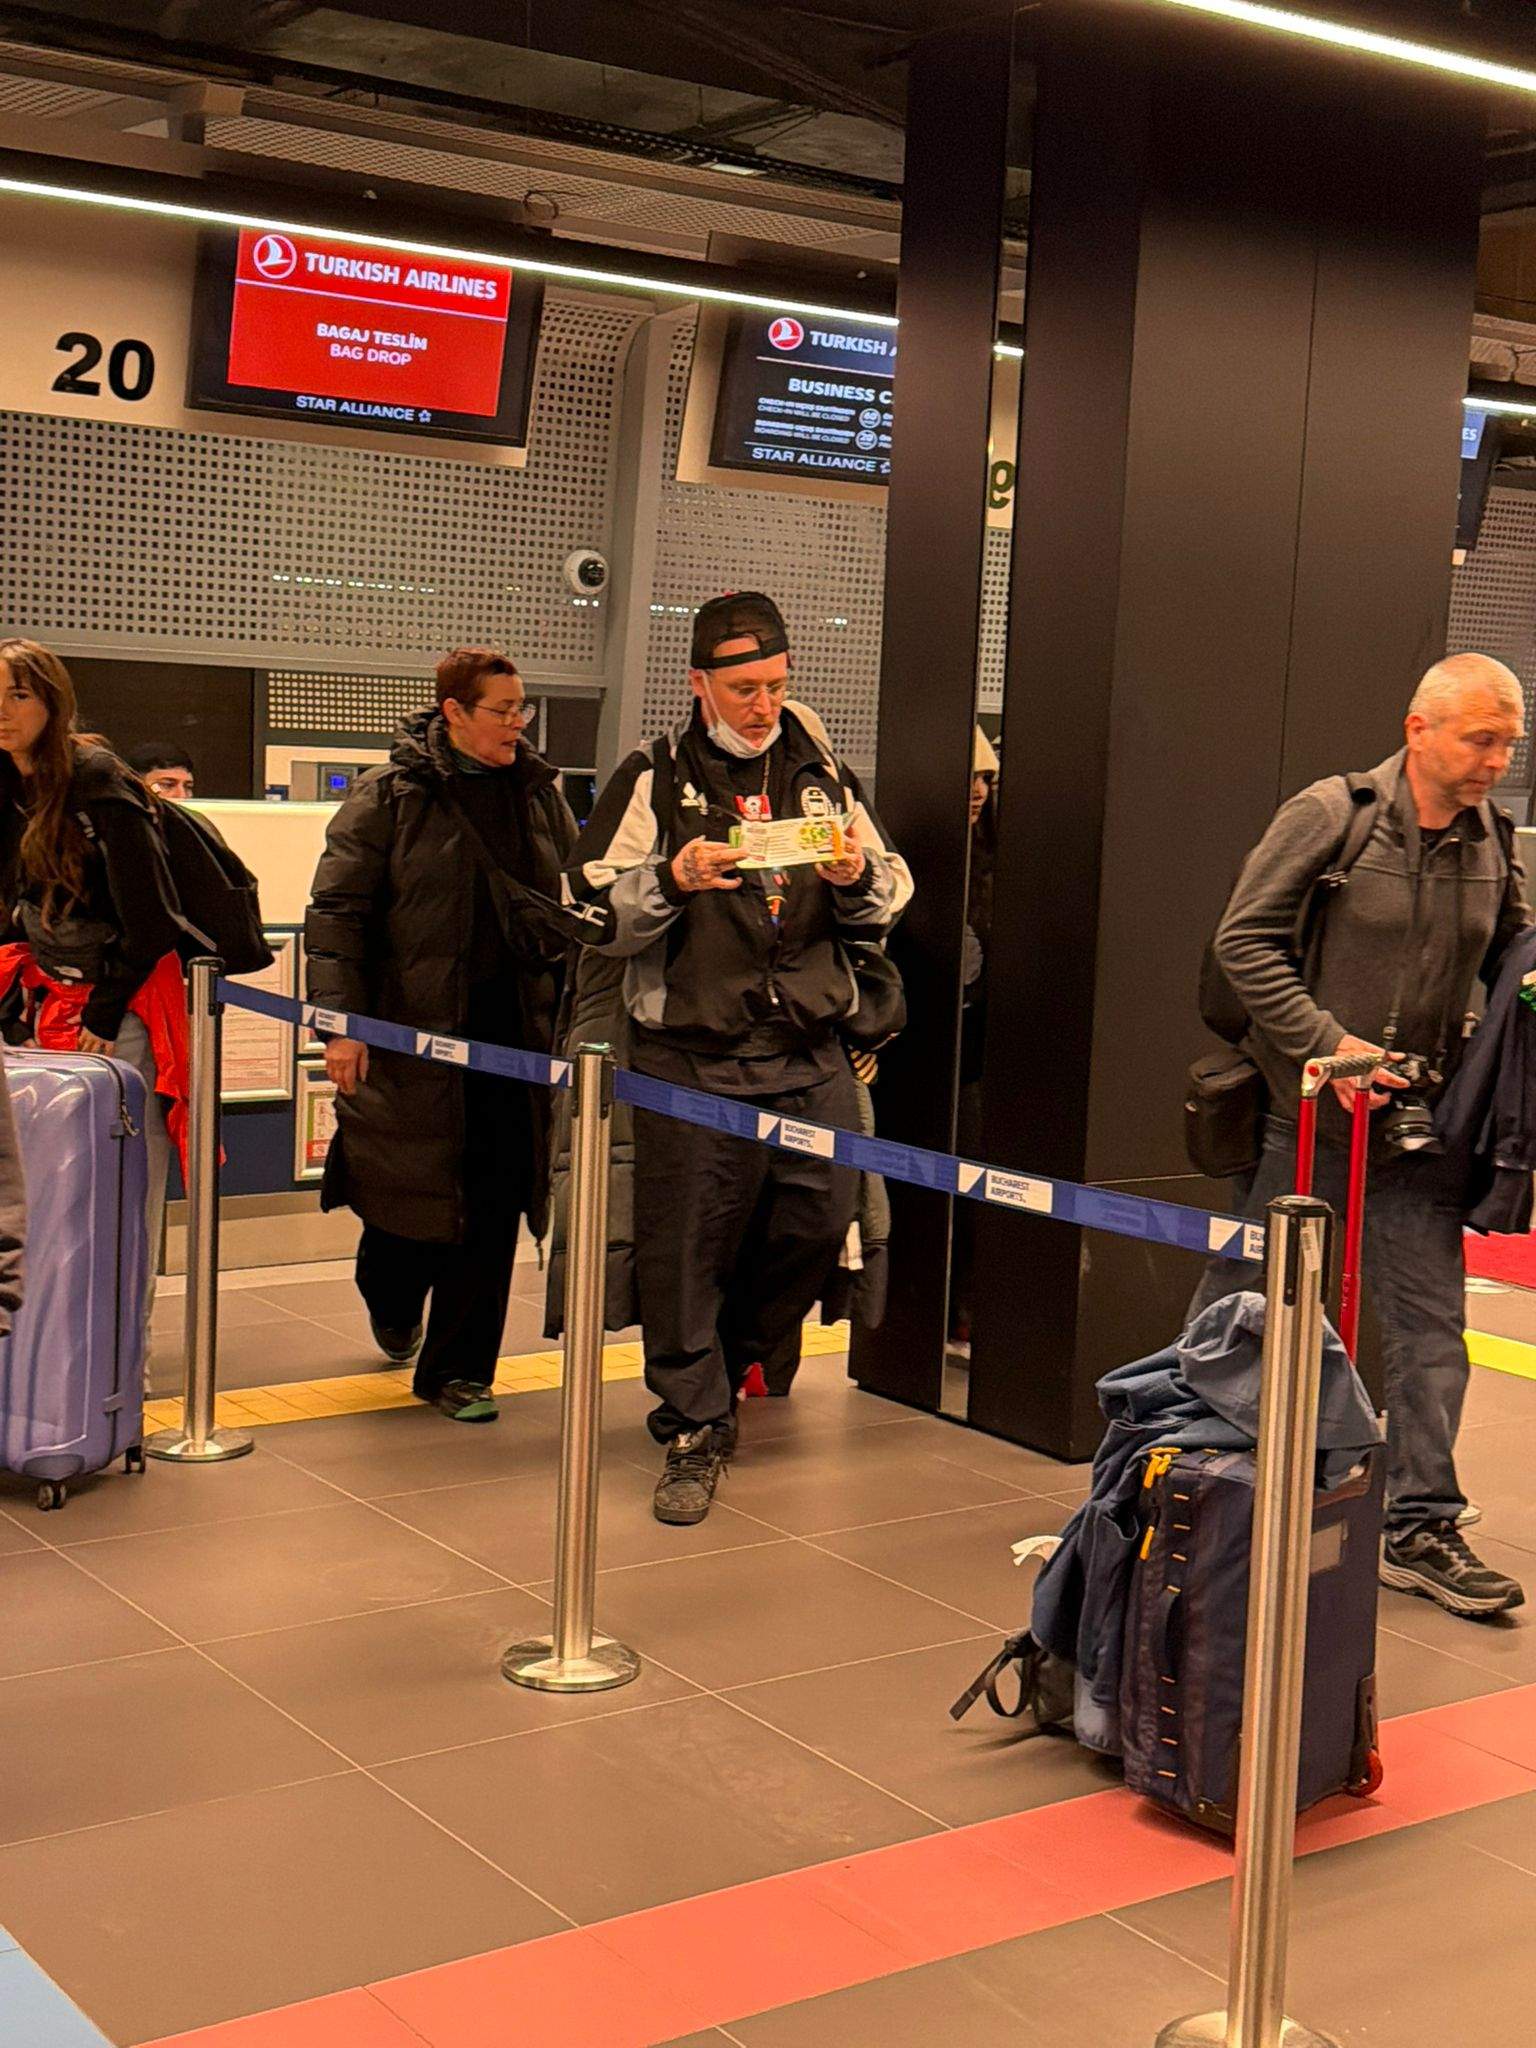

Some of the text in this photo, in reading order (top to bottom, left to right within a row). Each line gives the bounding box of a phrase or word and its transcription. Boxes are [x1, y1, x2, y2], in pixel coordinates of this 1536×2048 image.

[304, 252, 497, 299] TURKISH AIRLINES
[316, 322, 428, 350] BAGAJ TESLİM
[809, 330, 888, 355] TURKISH
[51, 332, 155, 401] 20
[329, 343, 412, 366] BAG DROP
[788, 377, 876, 402] BUSINESS
[295, 395, 415, 421] STAR ALLIANCE
[752, 447, 877, 472] STAR ALLIANCE
